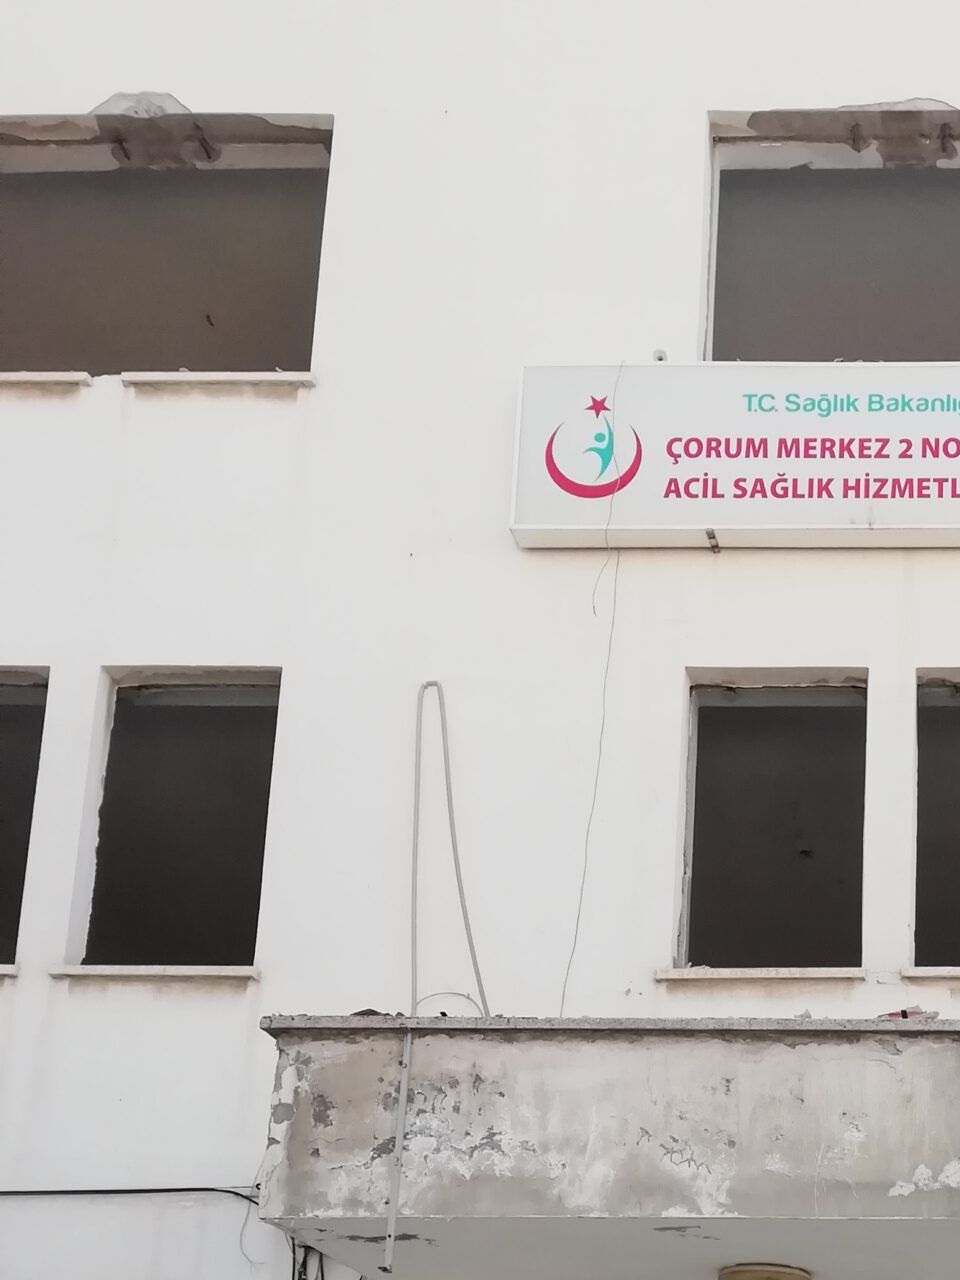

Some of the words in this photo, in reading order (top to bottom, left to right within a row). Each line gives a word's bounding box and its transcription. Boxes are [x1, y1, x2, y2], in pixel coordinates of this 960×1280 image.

[742, 393, 778, 412] T.C.
[785, 393, 860, 417] Sağlık
[666, 437, 768, 464] ÇORUM
[777, 437, 890, 458] MERKEZ
[898, 438, 913, 458] 2
[663, 472, 725, 498] ACİL
[733, 473, 835, 498] SAĞLIK
